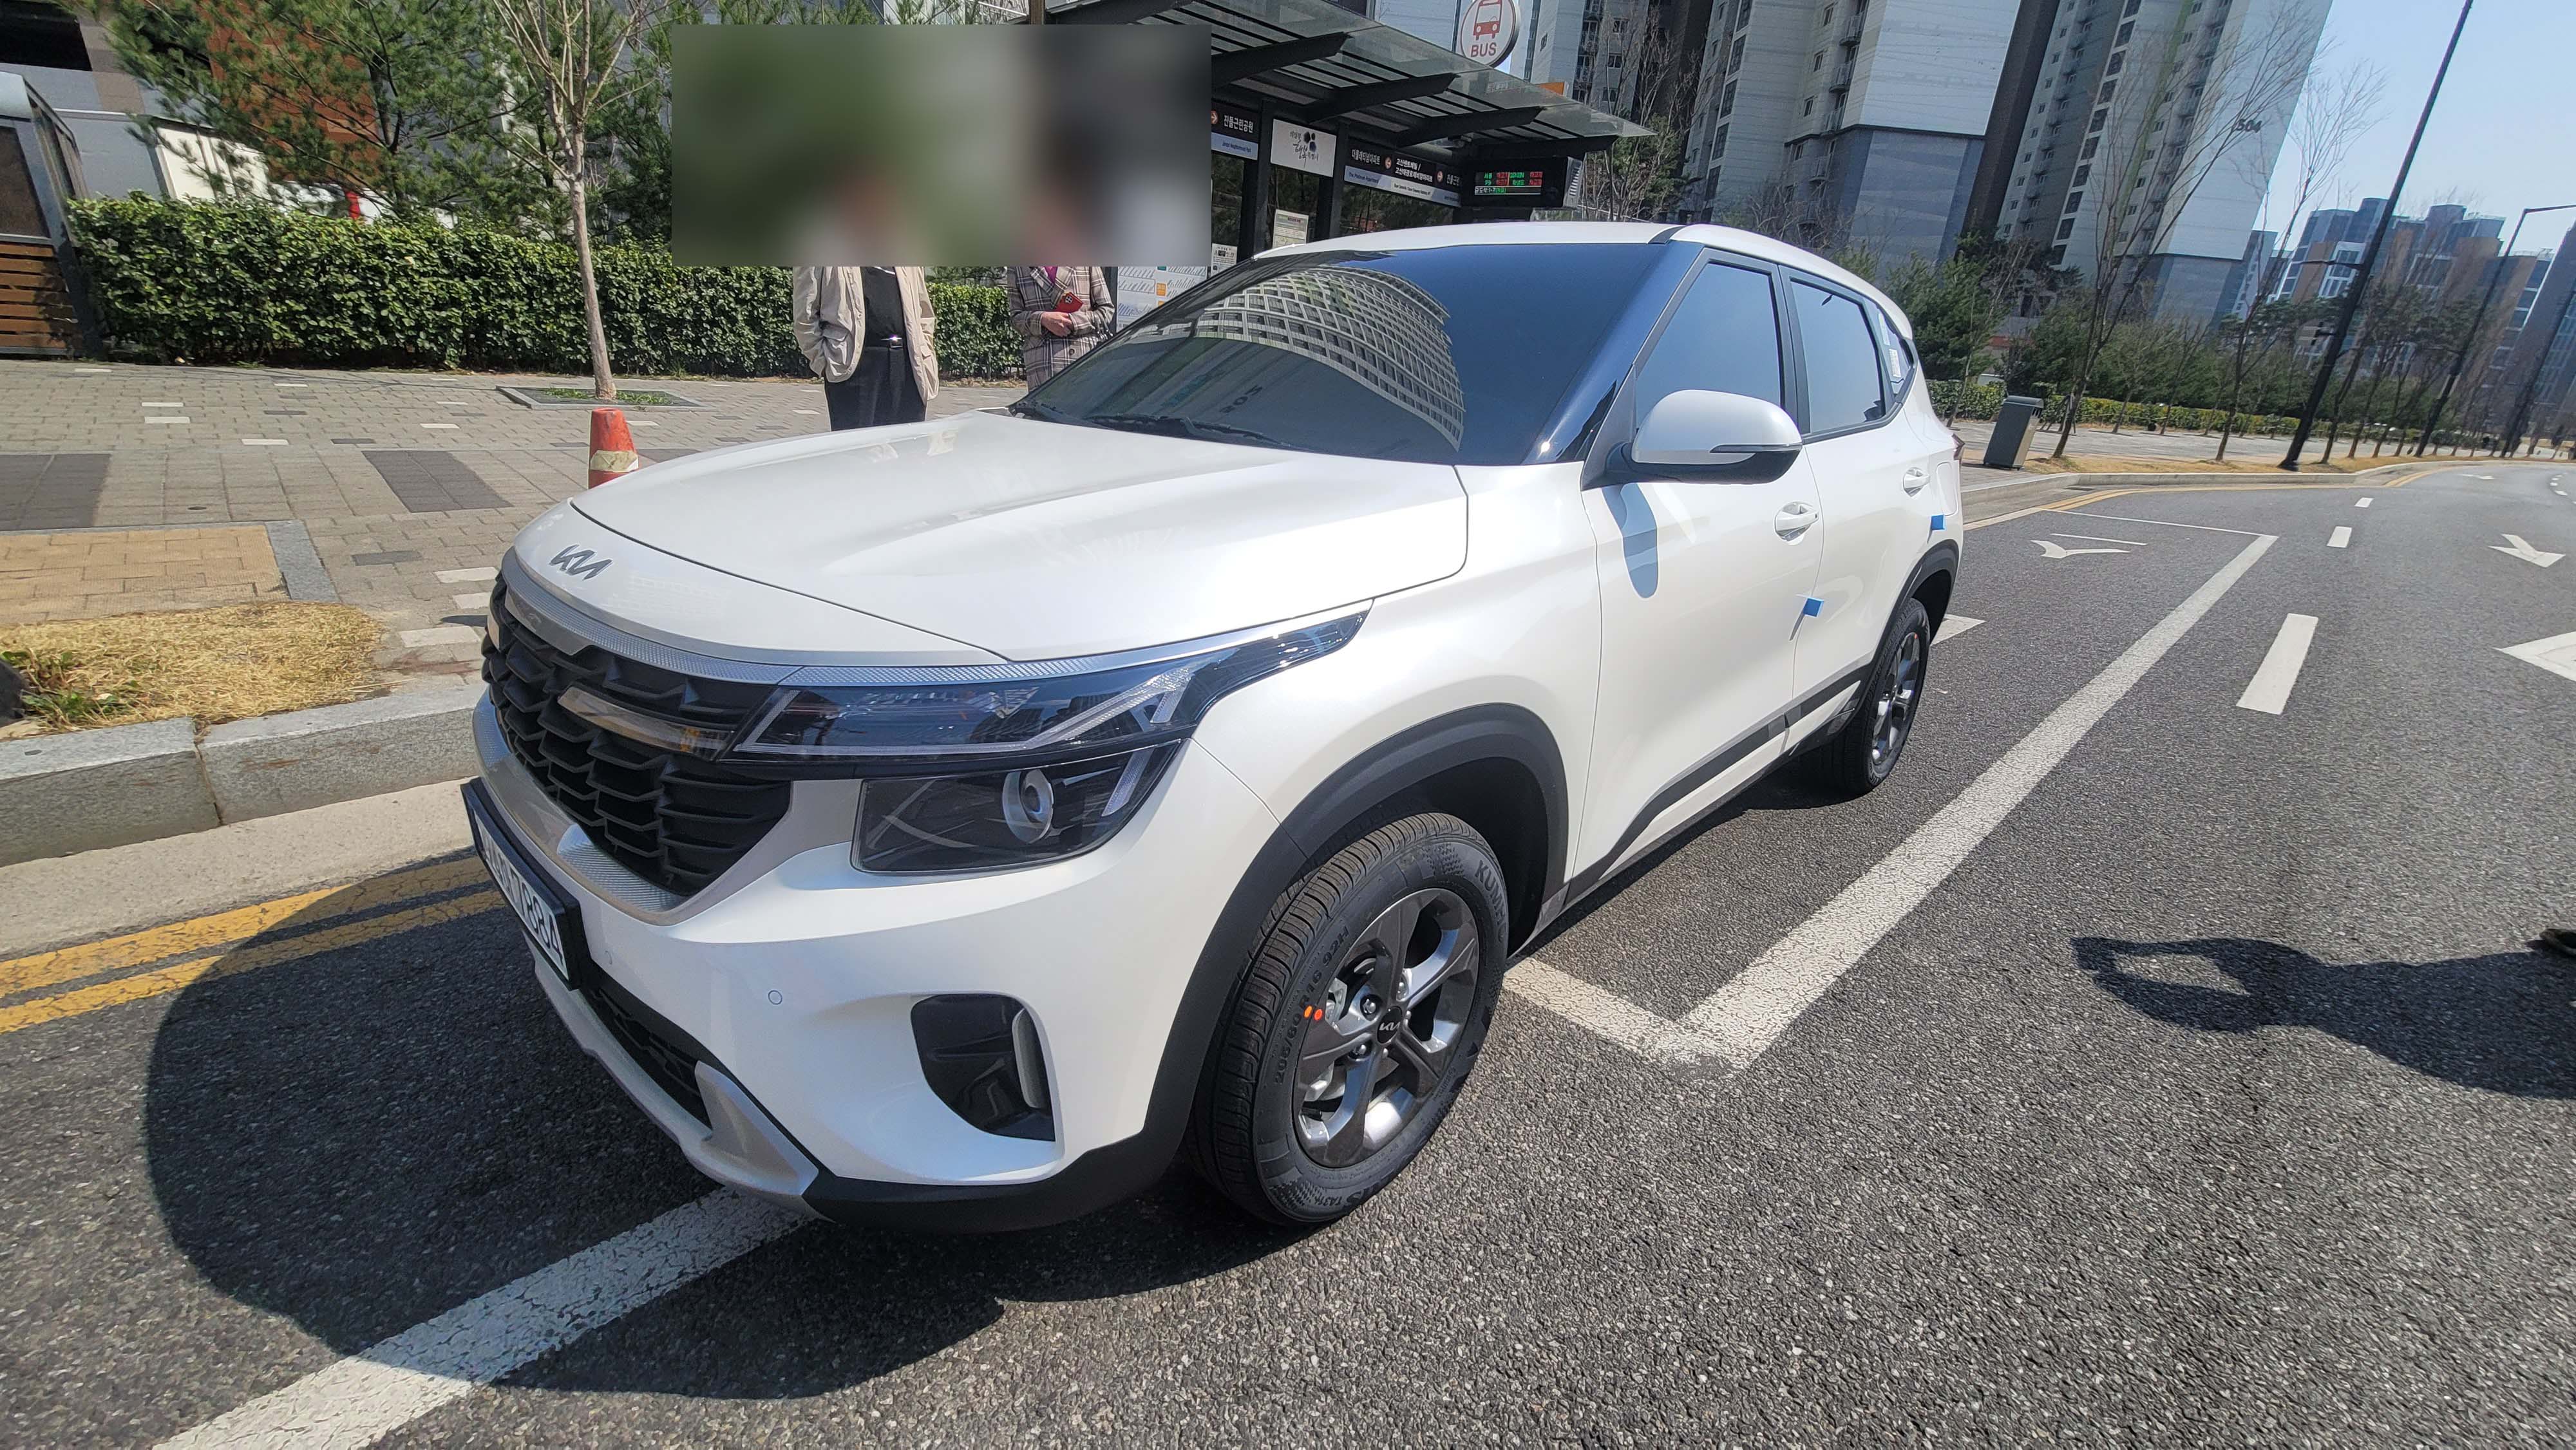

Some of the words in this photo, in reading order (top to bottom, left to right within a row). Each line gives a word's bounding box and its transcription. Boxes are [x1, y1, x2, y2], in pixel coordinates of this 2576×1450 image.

[1471, 42, 1497, 58] BUS
[2235, 118, 2262, 133] 504
[1475, 860, 1506, 943] KUMHO
[1322, 925, 1350, 967] 92H
